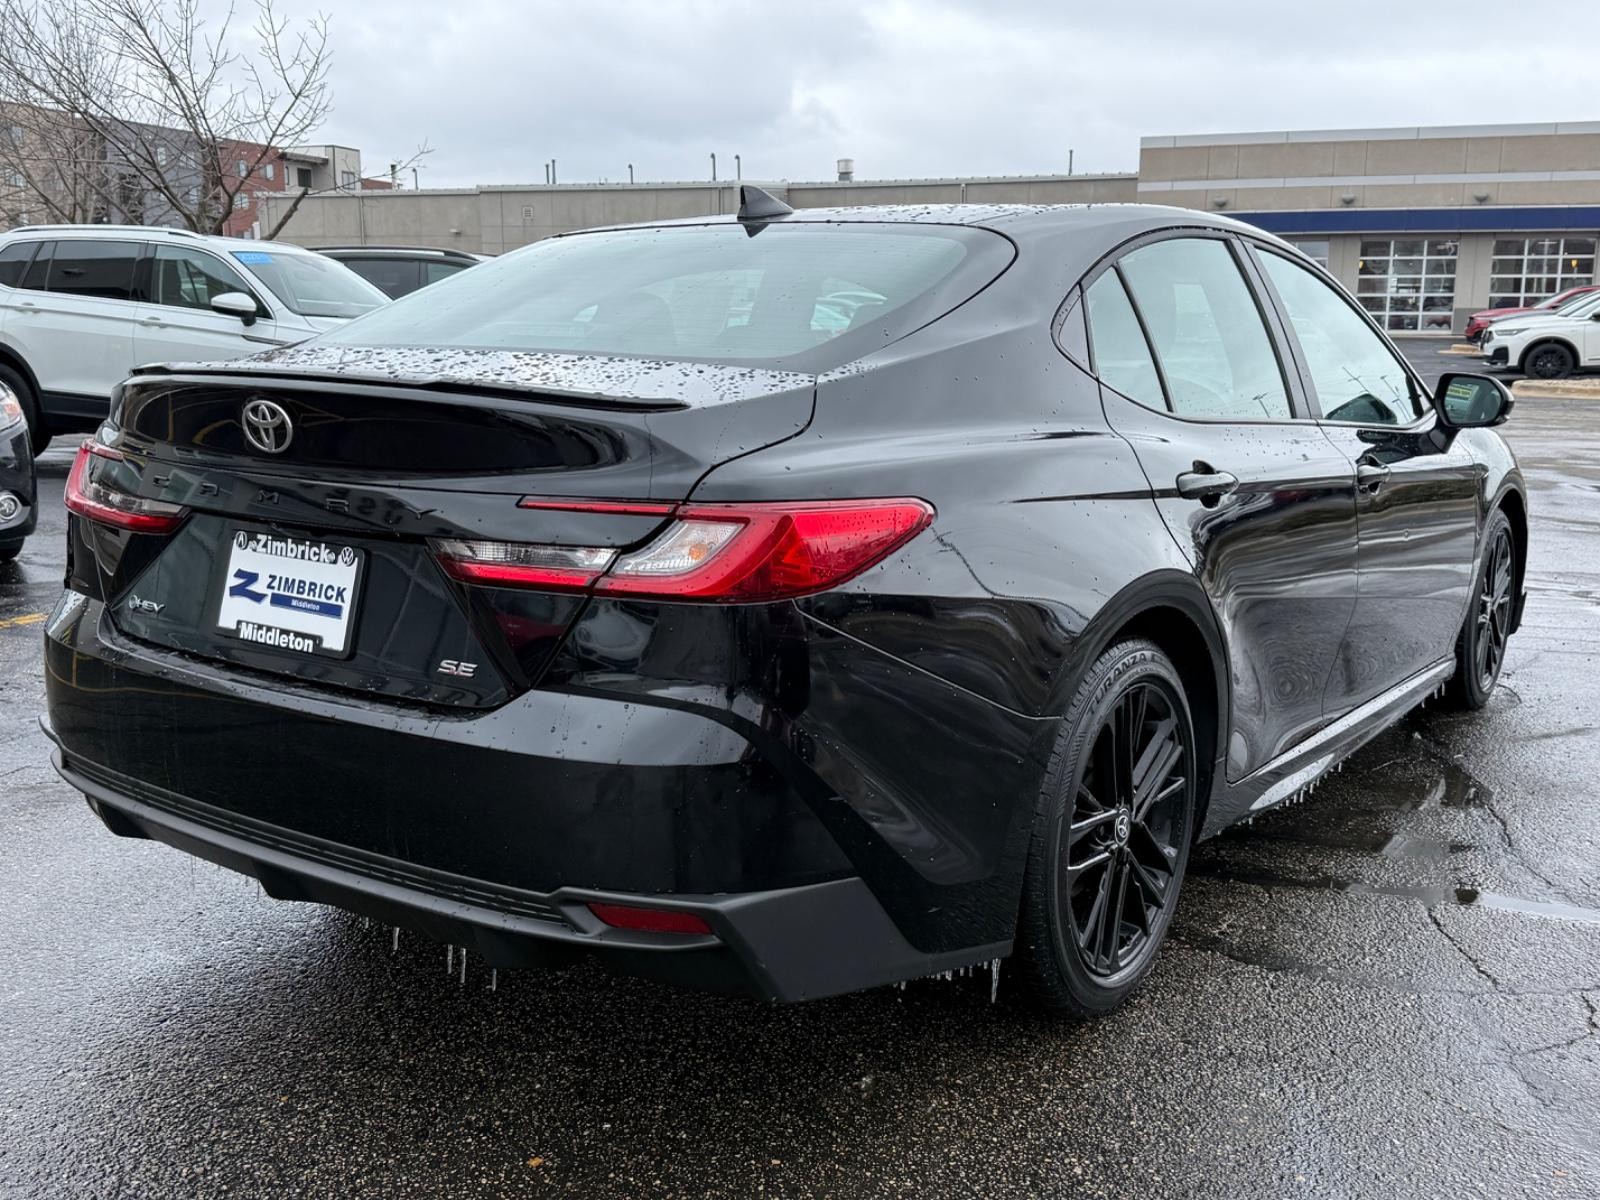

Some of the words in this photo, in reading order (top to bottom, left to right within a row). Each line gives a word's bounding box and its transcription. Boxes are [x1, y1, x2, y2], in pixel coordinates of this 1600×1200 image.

[152, 474, 437, 519] CAMRY
[256, 533, 331, 565] Zimbrick
[266, 574, 347, 603] ZIMBRICK
[291, 599, 320, 611] Middleton
[239, 621, 313, 653] Middleton
[437, 660, 478, 677] SE
[1089, 653, 1147, 714] TURANZA
